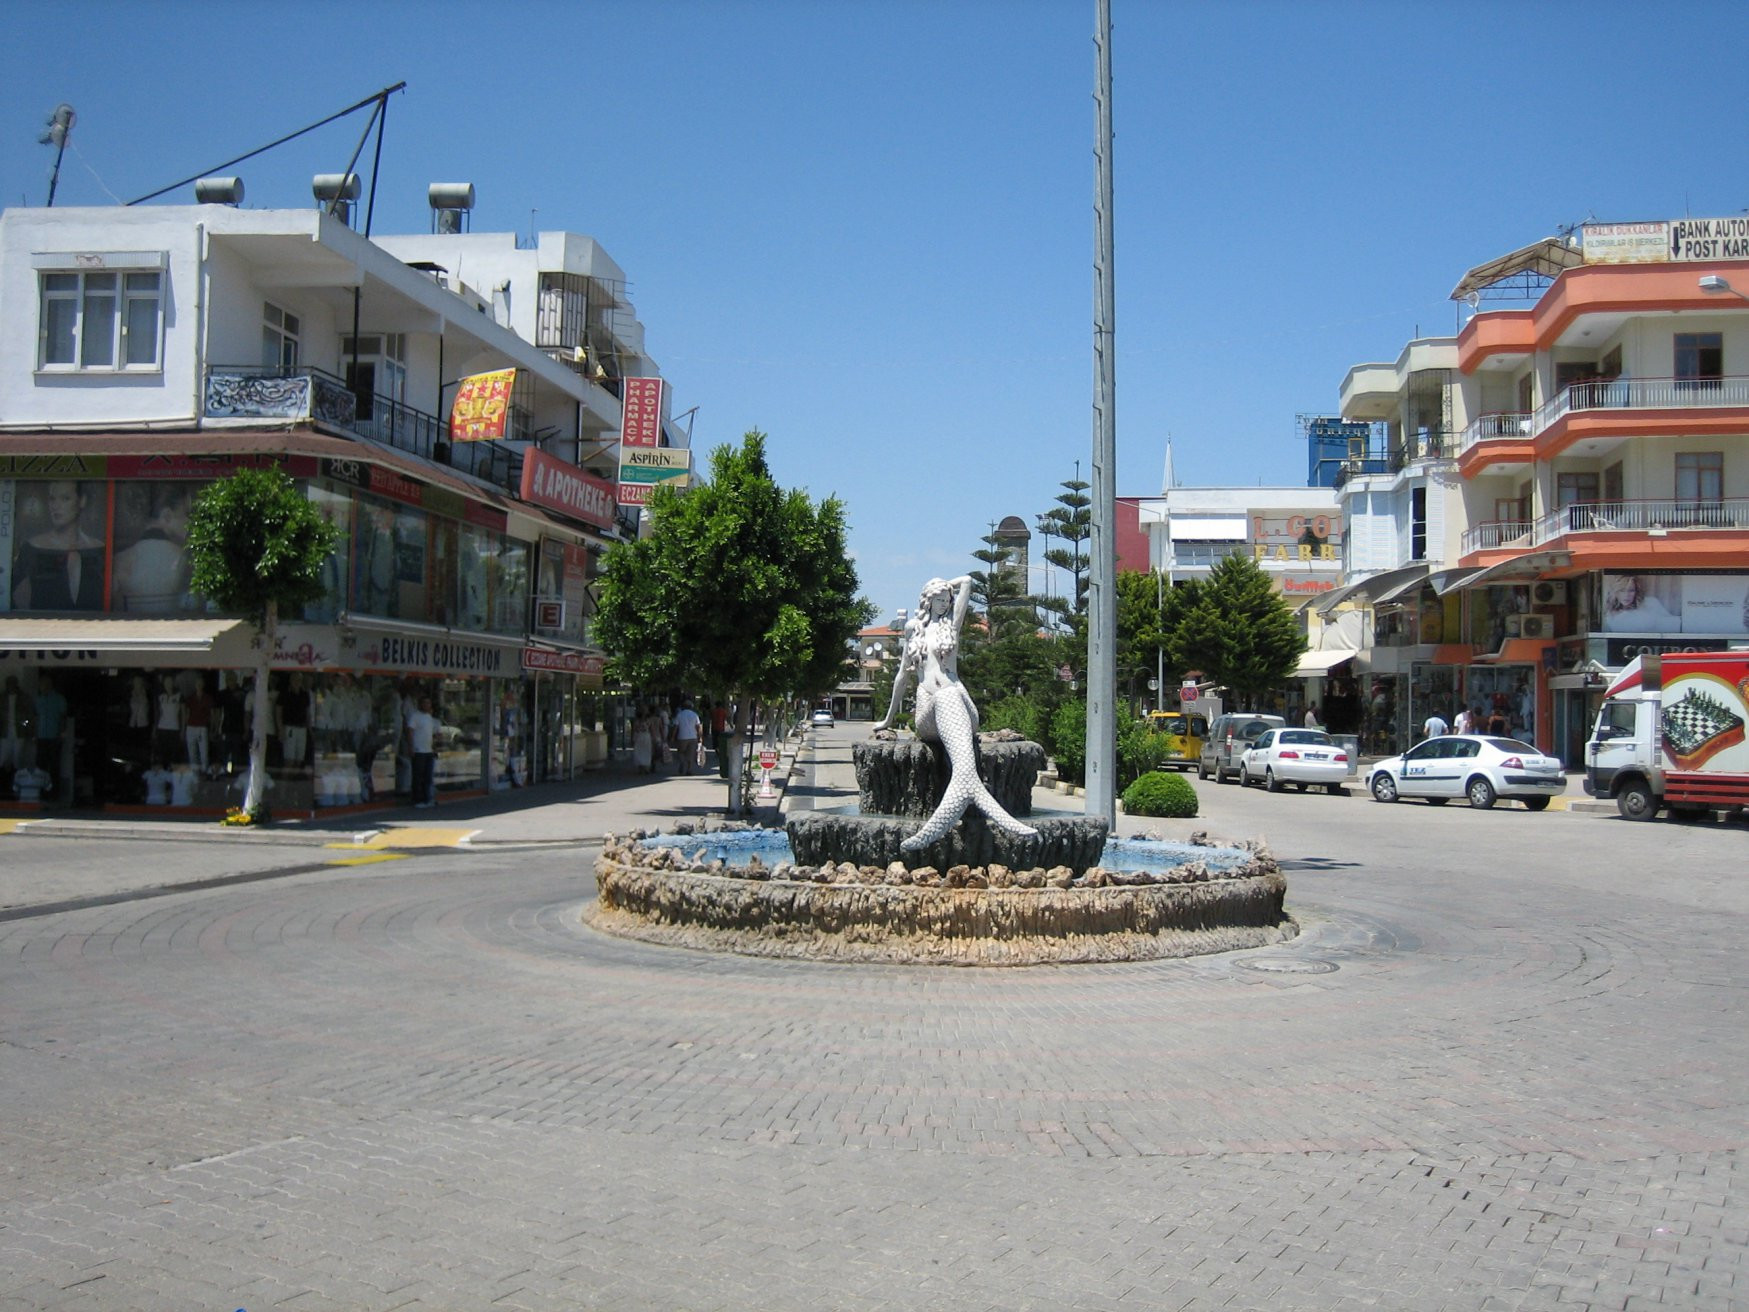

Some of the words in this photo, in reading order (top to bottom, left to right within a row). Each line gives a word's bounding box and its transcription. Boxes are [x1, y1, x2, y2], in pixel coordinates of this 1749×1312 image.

[1680, 221, 1710, 239] BANK
[1685, 240, 1718, 258] POST
[627, 381, 640, 443] PHARMACY
[642, 382, 656, 444] APOTHEKE
[546, 470, 605, 517] APOTHEKE
[382, 637, 427, 666] BELKIS
[433, 641, 500, 672] COLLECTION
